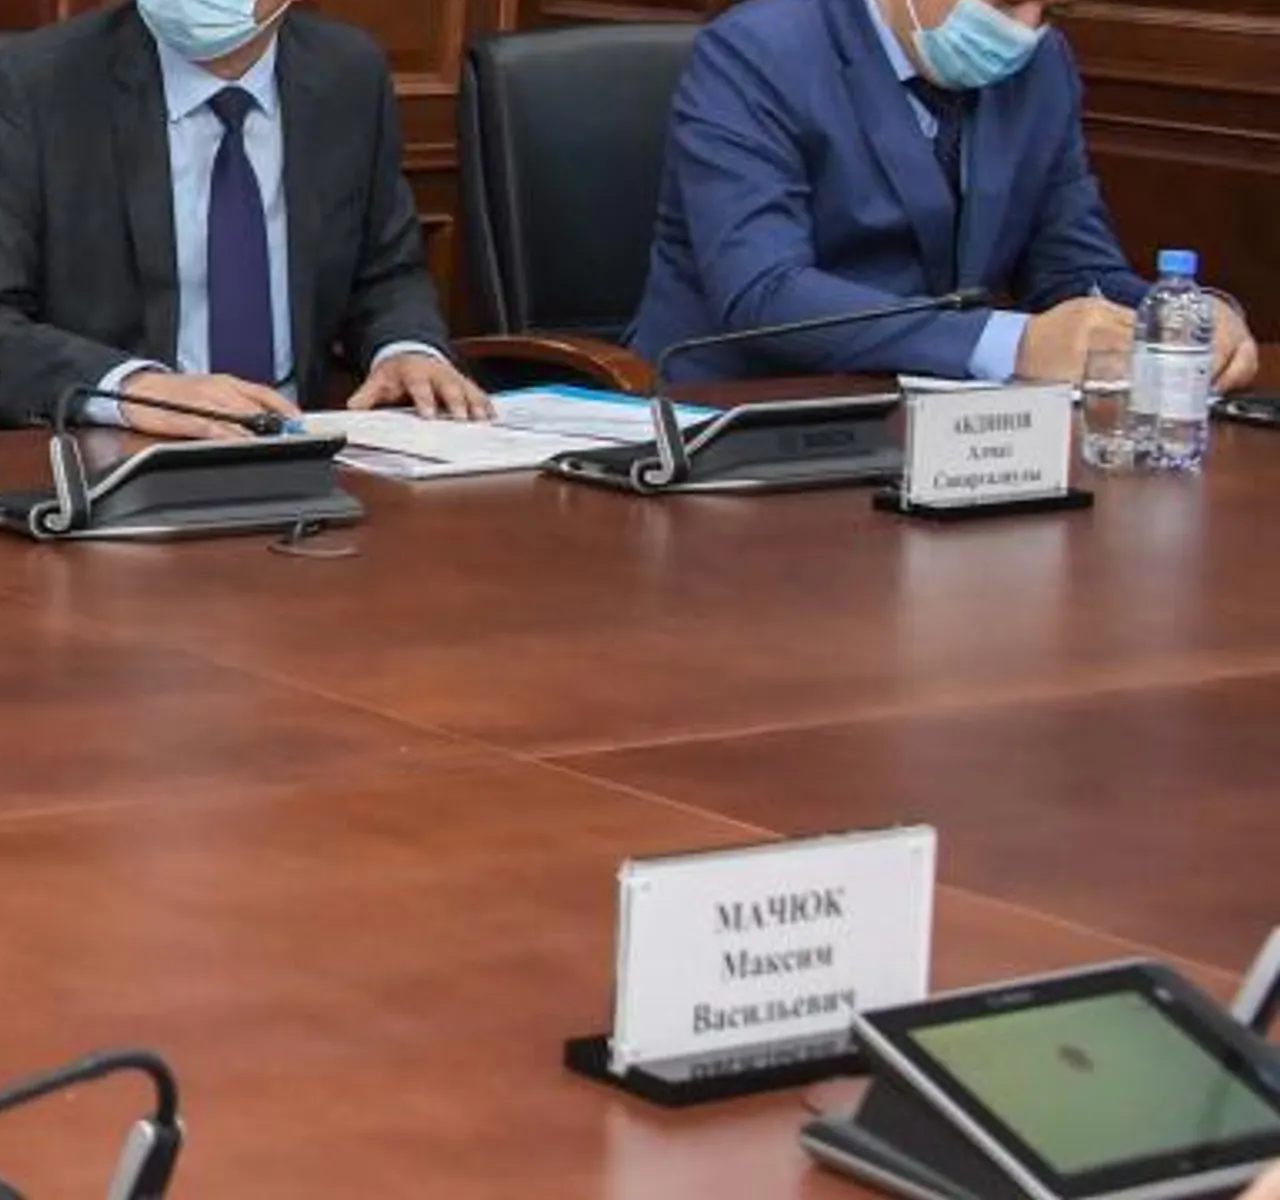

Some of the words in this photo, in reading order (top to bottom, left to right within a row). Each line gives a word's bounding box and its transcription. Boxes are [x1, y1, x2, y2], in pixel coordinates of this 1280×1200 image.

[716, 888, 844, 932] МАЧЮК
[724, 943, 833, 978] Максим
[692, 989, 855, 1033] Васильевич
